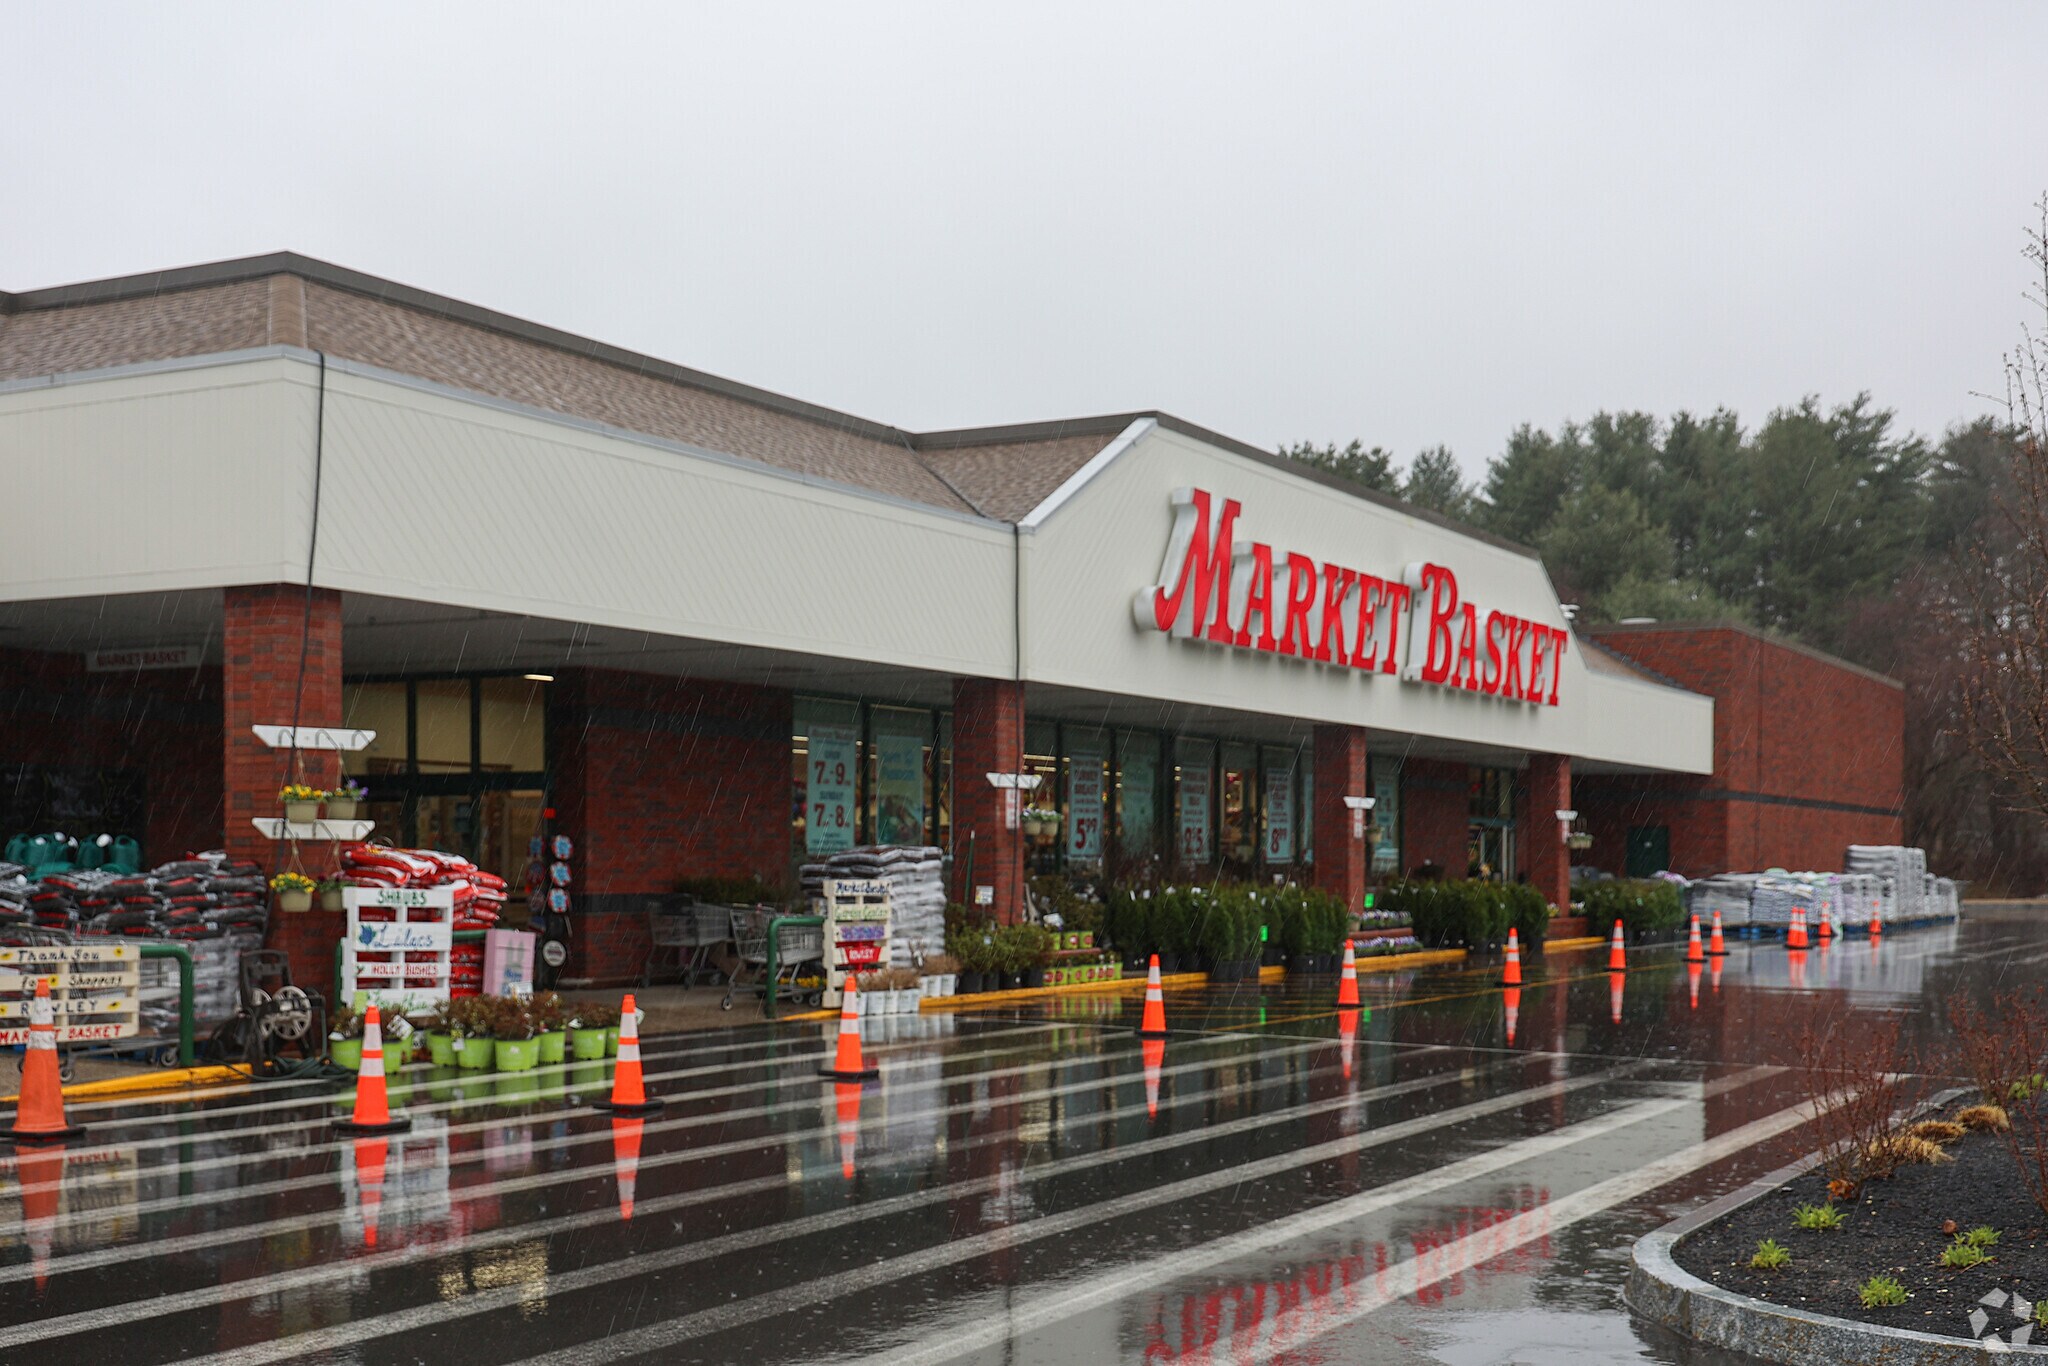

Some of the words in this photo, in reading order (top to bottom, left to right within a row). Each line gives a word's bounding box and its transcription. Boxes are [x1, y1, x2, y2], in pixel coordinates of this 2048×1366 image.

[1154, 488, 1409, 675] MARKET
[1420, 562, 1568, 706] BASKET
[377, 889, 427, 905] SHRUBS
[373, 921, 433, 948] Lilacs
[18, 949, 67, 962] Thank
[20, 975, 38, 988] fo
[20, 1000, 98, 1015] RWLEY
[0, 1029, 62, 1045] MART
[68, 1025, 123, 1040] BASKET
